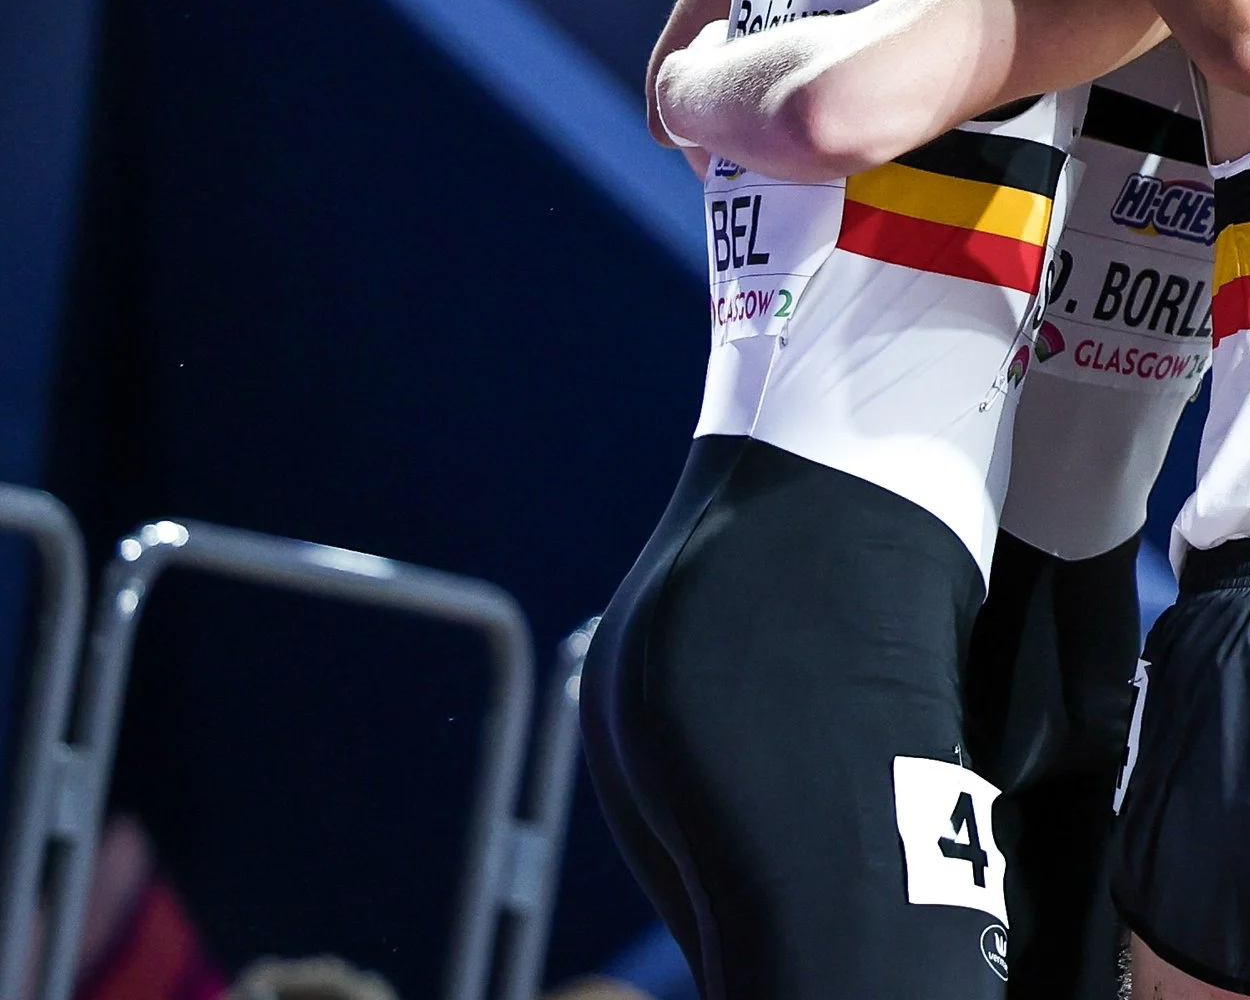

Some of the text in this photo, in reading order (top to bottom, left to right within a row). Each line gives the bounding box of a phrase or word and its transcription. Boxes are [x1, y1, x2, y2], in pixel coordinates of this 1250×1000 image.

[712, 195, 770, 272] BEL
[1111, 173, 1215, 246] HI-CHE
[937, 791, 989, 889] 4
